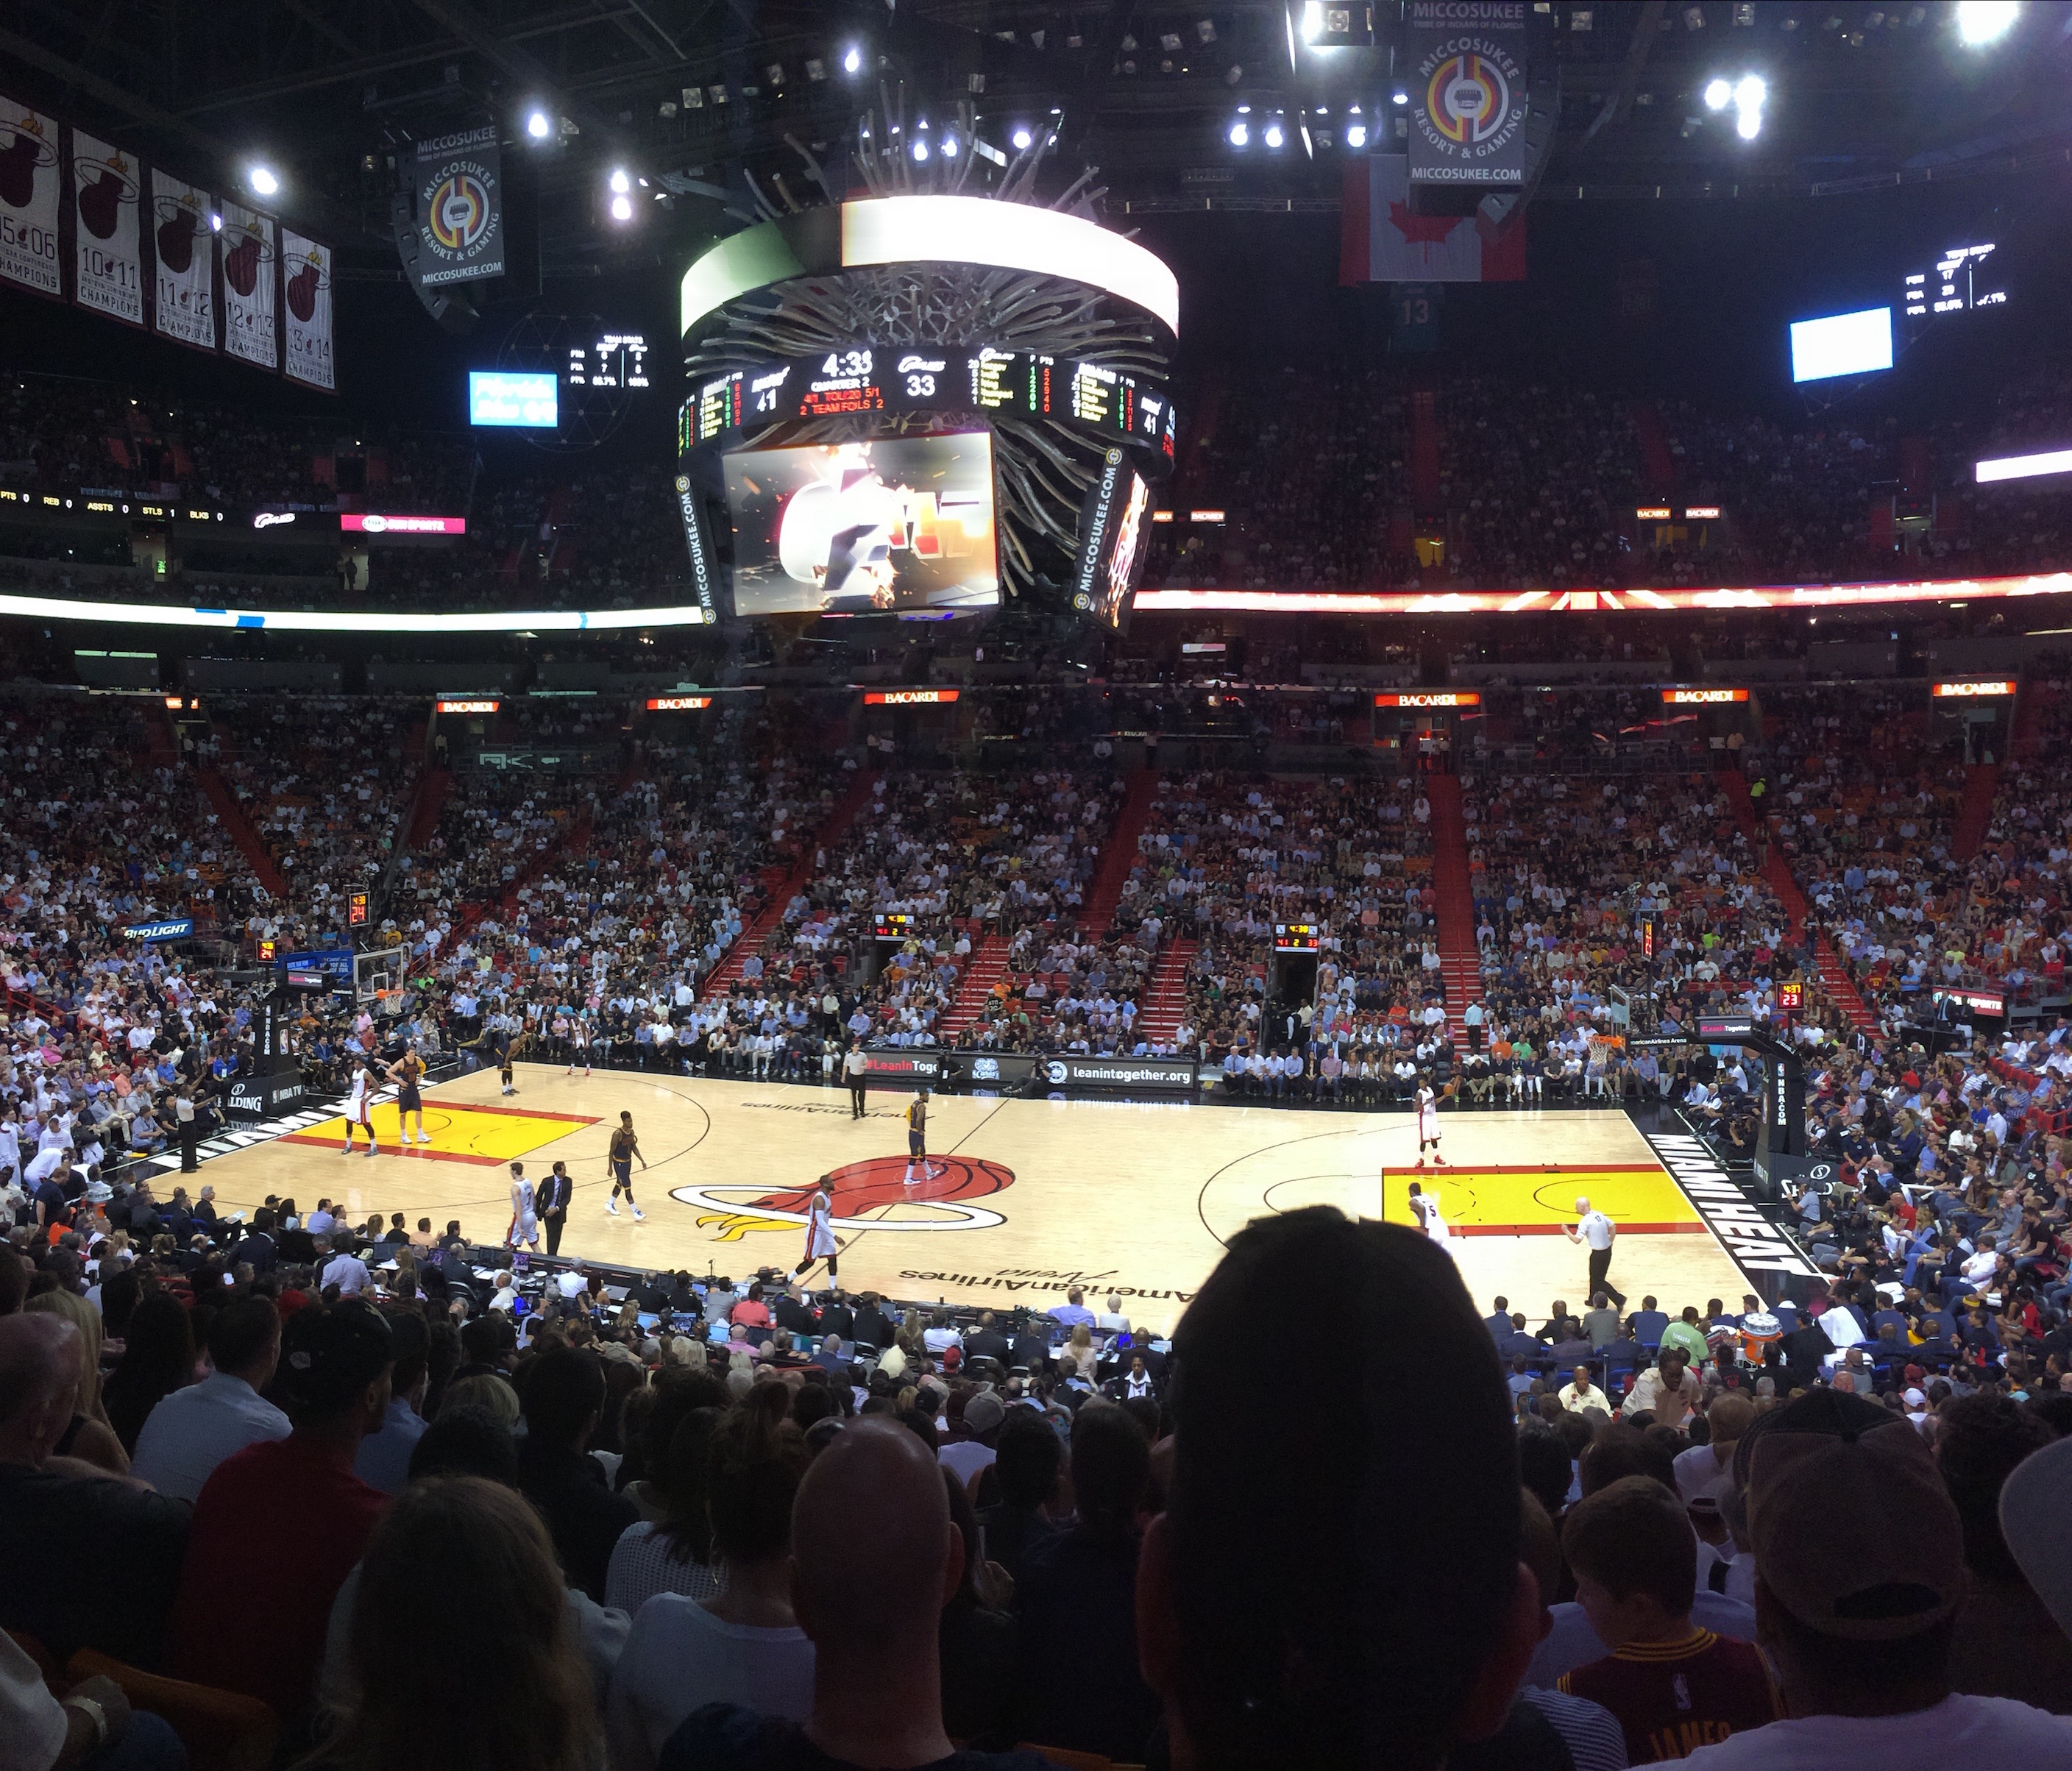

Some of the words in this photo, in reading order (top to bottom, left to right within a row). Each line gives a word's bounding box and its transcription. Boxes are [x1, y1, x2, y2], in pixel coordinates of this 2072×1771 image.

[1413, 2, 1524, 19] MICCOSUKEE
[1447, 21, 1478, 29] INDIANS
[1480, 21, 1490, 29] OF
[1492, 21, 1525, 29] FLORIDA
[1419, 37, 1519, 79] MICCOSUKEE
[417, 126, 496, 154] MICCOSUKEE
[1414, 107, 1456, 155] RESORT
[1461, 147, 1472, 158] &
[1476, 109, 1522, 157] GAMING
[423, 160, 496, 201] MICCOSUKEE
[1412, 167, 1522, 180] MICCOSUKEE.COM
[32, 227, 54, 260] 06
[422, 225, 453, 260] RESORT
[456, 251, 464, 261] &
[467, 213, 500, 257] GAMING
[0, 259, 57, 288] HAMPIONS
[82, 247, 103, 276] 10
[118, 261, 137, 289] 11
[422, 261, 502, 284] MICCOSUKEE.COM
[80, 285, 139, 318] CHAMPIONS
[160, 278, 176, 306] 11
[193, 294, 210, 316] 12
[227, 302, 244, 328] 12
[258, 316, 274, 338] 13
[1402, 299, 1429, 325] 13
[289, 328, 303, 352] 13
[316, 338, 330, 359] 14
[288, 362, 332, 384] CHAMPIONS
[862, 376, 870, 388] 2
[865, 387, 880, 397] 5/1
[907, 375, 935, 397] 33
[756, 389, 776, 412] 41
[800, 405, 807, 415] 2
[876, 399, 884, 409] 2
[1144, 414, 1156, 435] 41
[1, 491, 17, 500] PTS
[23, 493, 29, 503] 0
[43, 497, 60, 506] REB
[66, 499, 72, 508] 0
[88, 503, 113, 511] ASSTS
[122, 505, 129, 514] 0
[143, 506, 163, 516] STLS
[190, 511, 209, 519] BLKS
[217, 512, 223, 522] 0
[1637, 509, 1670, 517] BACARDI
[1080, 467, 1117, 592] MICCOSUKEE.COM
[681, 492, 712, 607] MICCOSUKEE.COM
[885, 692, 939, 703] BACARDI
[1675, 689, 1734, 703] BACARDI
[1941, 681, 2009, 695] BACARDI
[443, 701, 495, 712] BACARDI
[658, 698, 703, 709] BACARDI
[1398, 694, 1458, 706] BACARDI
[352, 906, 365, 923] 24
[152, 923, 188, 937] LIGHT
[1293, 938, 1299, 947] 2
[1308, 939, 1318, 947] 33
[260, 950, 272, 959] 24
[1784, 984, 1800, 993] 4:37
[1783, 994, 1798, 1006] 23
[1074, 1067, 1191, 1084] leanintogether.org
[280, 1087, 293, 1100] NBA
[293, 1085, 302, 1096] TV
[1428, 1205, 1436, 1217] 5
[1646, 1133, 1747, 1199] MIAMI
[1697, 1201, 1823, 1277] HEAT
